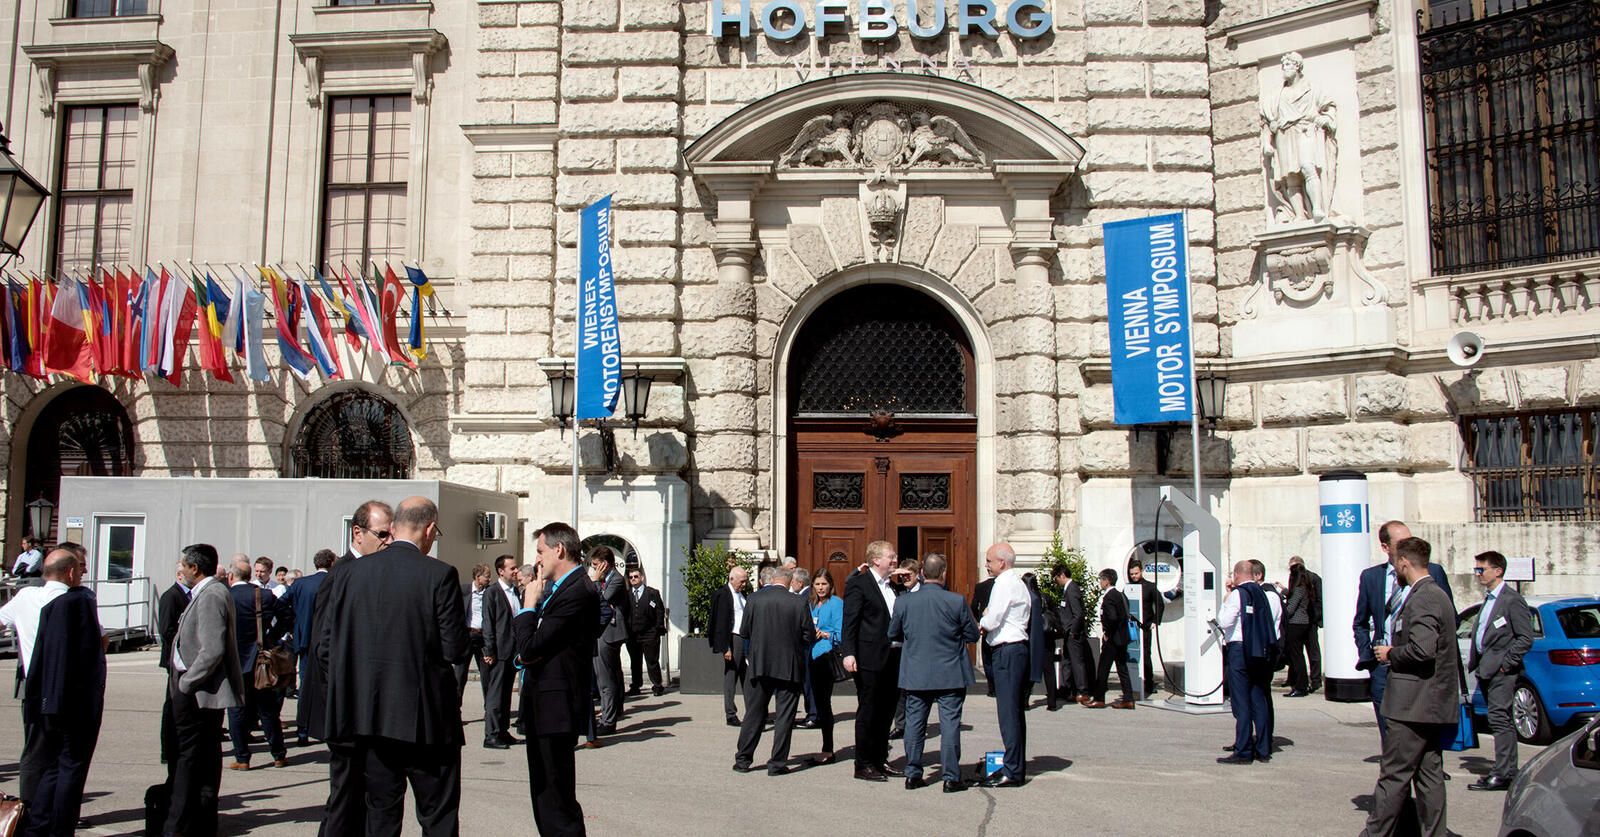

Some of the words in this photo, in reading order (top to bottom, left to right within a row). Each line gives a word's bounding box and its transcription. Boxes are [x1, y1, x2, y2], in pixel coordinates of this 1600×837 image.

[712, 0, 1053, 39] HOFBURG
[792, 55, 971, 71] VIENNA
[583, 277, 599, 350] WIENER
[597, 207, 620, 408] MOTORENSYMPOSIUM
[1149, 222, 1181, 335] SYMPOSIUM
[1122, 286, 1151, 358] VIENNA
[1156, 342, 1186, 412] MOTOR
